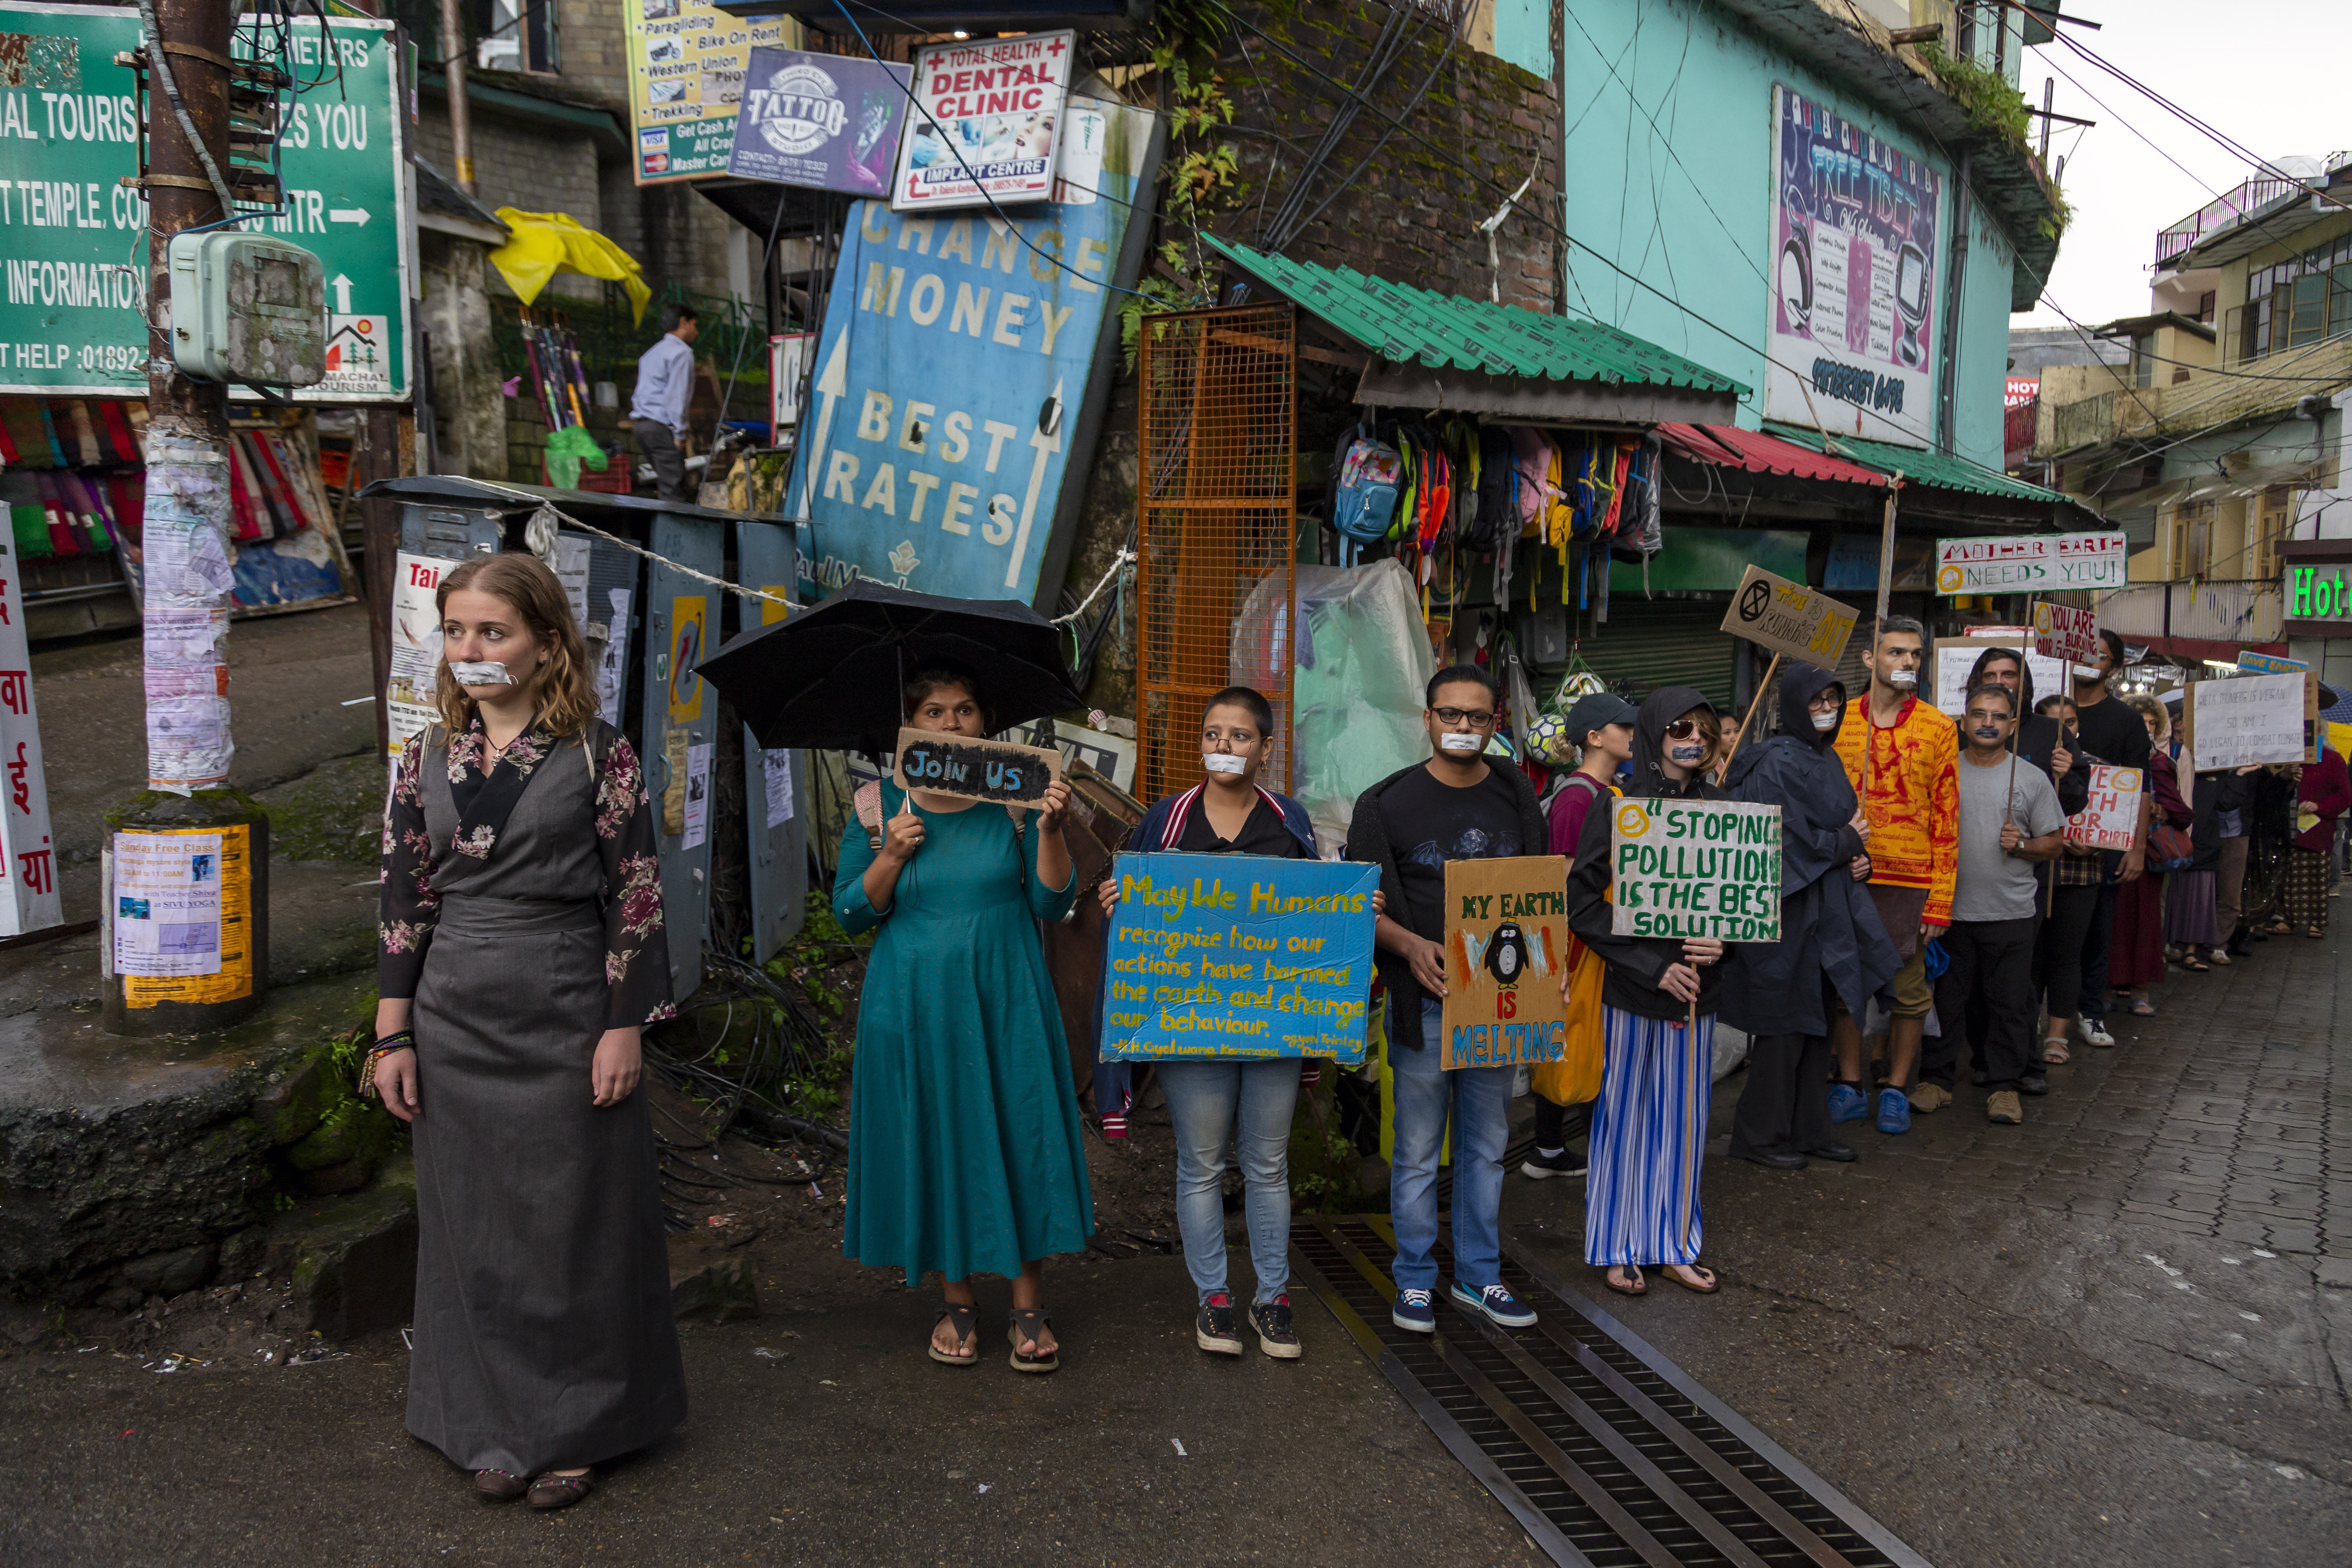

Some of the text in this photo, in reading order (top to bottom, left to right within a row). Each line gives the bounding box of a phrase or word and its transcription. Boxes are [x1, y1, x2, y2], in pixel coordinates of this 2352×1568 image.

[646, 16, 715, 35] Paragliding
[699, 25, 781, 49] Bike On Rent
[286, 36, 369, 68] METERS
[950, 41, 1042, 68] TOTAL HEALTH
[648, 56, 738, 77] Western Union
[932, 62, 1056, 95] DENTAL
[652, 104, 702, 120] Trekking
[748, 89, 848, 136] TATTOO
[936, 87, 1044, 118] CLINIC
[0, 92, 38, 139] AL
[41, 92, 149, 143] TOURIS
[315, 103, 367, 151] YOU
[677, 124, 696, 138] Get
[697, 119, 724, 135] Cash
[694, 138, 709, 153] All
[672, 157, 708, 171] Master
[926, 159, 1042, 183] IMPLANT CENTRE
[17, 180, 107, 229] TEMPLE,
[1811, 144, 1918, 240] FREE TIBET
[862, 202, 1109, 293] CHANGE
[7, 259, 147, 310] INFORMATION
[859, 260, 1074, 355] MONEY
[16, 343, 70, 369] HELP
[1812, 356, 1874, 405] INTERNET
[2008, 381, 2040, 394] HOT
[856, 388, 1017, 473] BEST
[822, 449, 1017, 546] RATES
[1943, 537, 2123, 560] MOTHER EARTH
[410, 562, 440, 589] Tai
[1968, 560, 2115, 586] NEEDS YOU!
[2292, 568, 2352, 616] Hot
[1809, 609, 1855, 660] OUT
[2051, 605, 2096, 640] YOU ARE
[2037, 637, 2084, 663] OUR FUTURE
[2065, 632, 2098, 656] BURNING
[2240, 654, 2306, 673] SAVE EARTH
[2198, 688, 2286, 706] GRETA THUNBERG IS VEGAN
[2227, 714, 2267, 728] SO AM I
[2198, 732, 2301, 748] GO VEGAN TO COMBAT CLIMATE
[985, 761, 1023, 791] US
[120, 841, 214, 853] Sunday Free Class
[2097, 829, 2135, 850] BIRTH
[1618, 843, 1781, 884] POLLUTION
[193, 890, 216, 898] Shiva
[1122, 874, 1367, 923] May We Humans
[1461, 891, 1565, 920] MY EARTH
[1620, 881, 1781, 919] IS THE BEST
[1634, 912, 1778, 940] SOLUTION
[1119, 925, 1327, 958] recognize how our
[1114, 952, 1351, 986] actions have harmed
[1111, 980, 1366, 1030] the earth and change
[1497, 992, 1517, 1020] IS
[1109, 1006, 1270, 1038] our behaviour.
[1321, 1033, 1363, 1053] Trinley
[1452, 1020, 1564, 1068] MELTING
